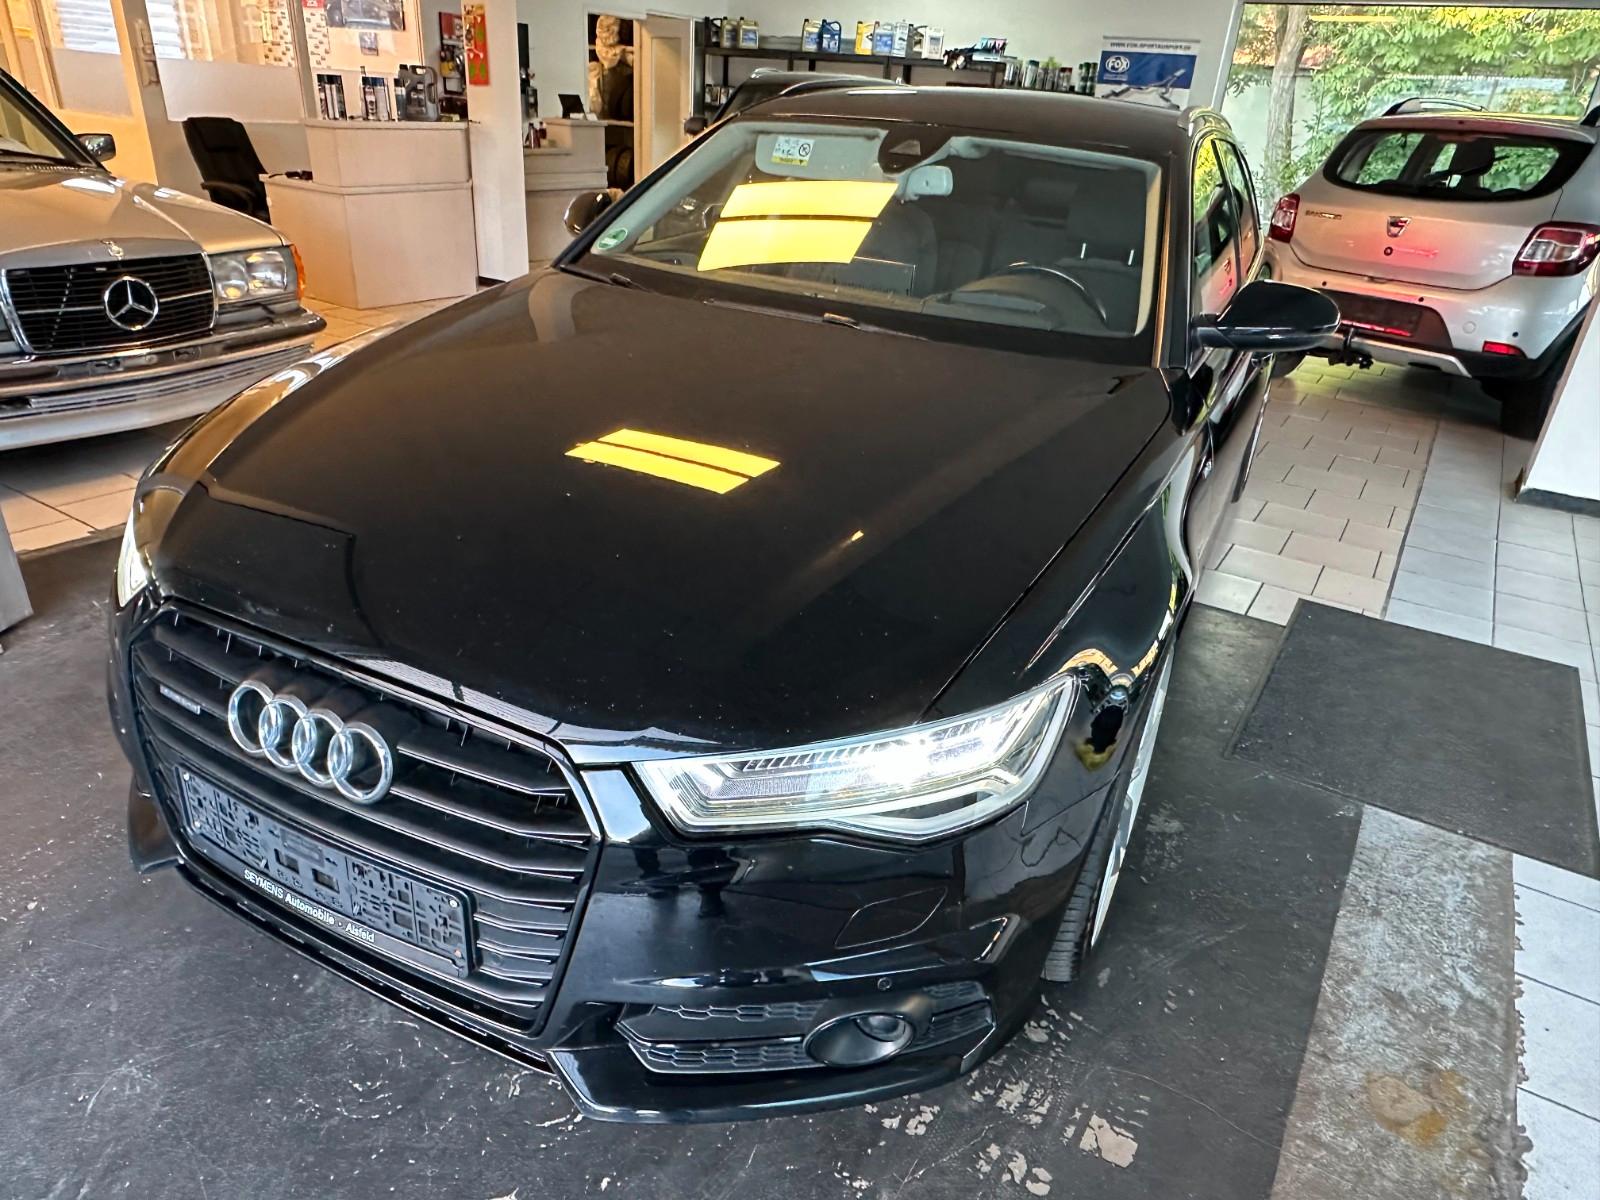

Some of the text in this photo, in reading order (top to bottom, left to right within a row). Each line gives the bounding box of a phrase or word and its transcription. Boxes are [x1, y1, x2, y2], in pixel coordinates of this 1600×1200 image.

[1108, 57, 1128, 71] FOX
[244, 869, 375, 943] SEYMENS Automobile Alsfeld
